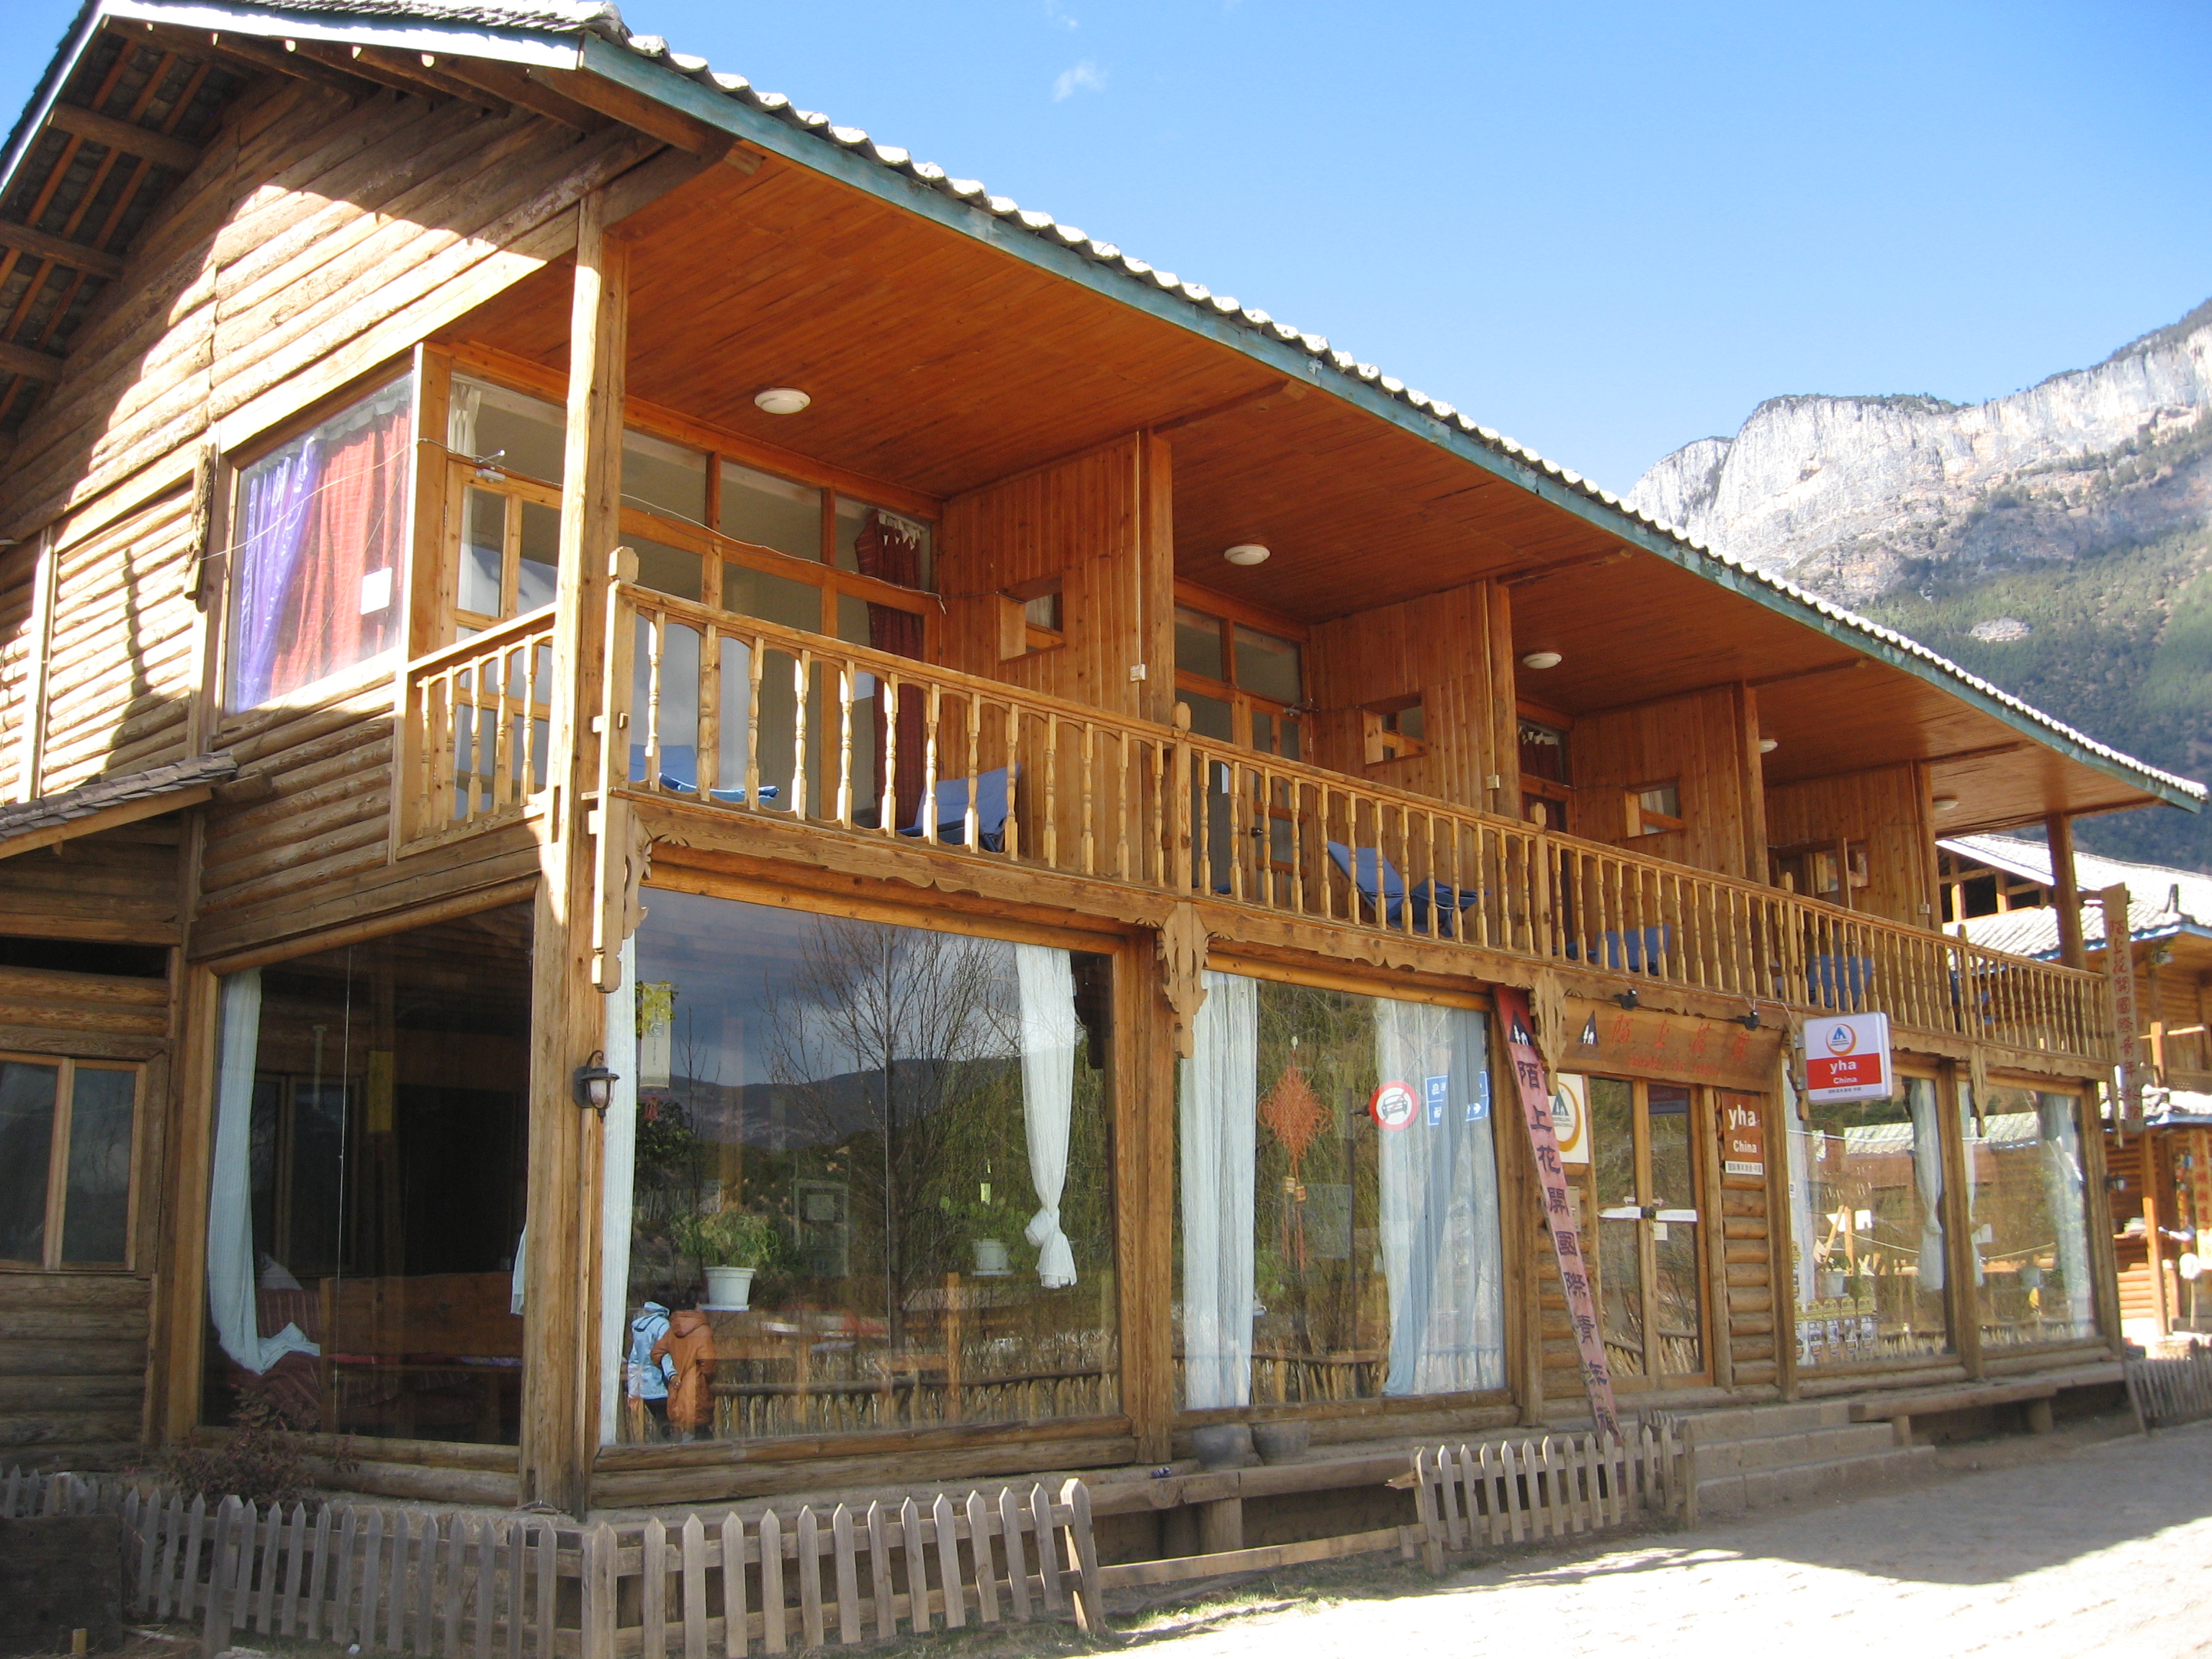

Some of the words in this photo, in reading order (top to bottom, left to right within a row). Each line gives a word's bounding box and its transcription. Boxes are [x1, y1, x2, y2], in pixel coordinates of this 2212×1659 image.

[1830, 1059, 1857, 1074] yha
[1728, 1104, 1756, 1130] yha
[1732, 1139, 1758, 1154] China
